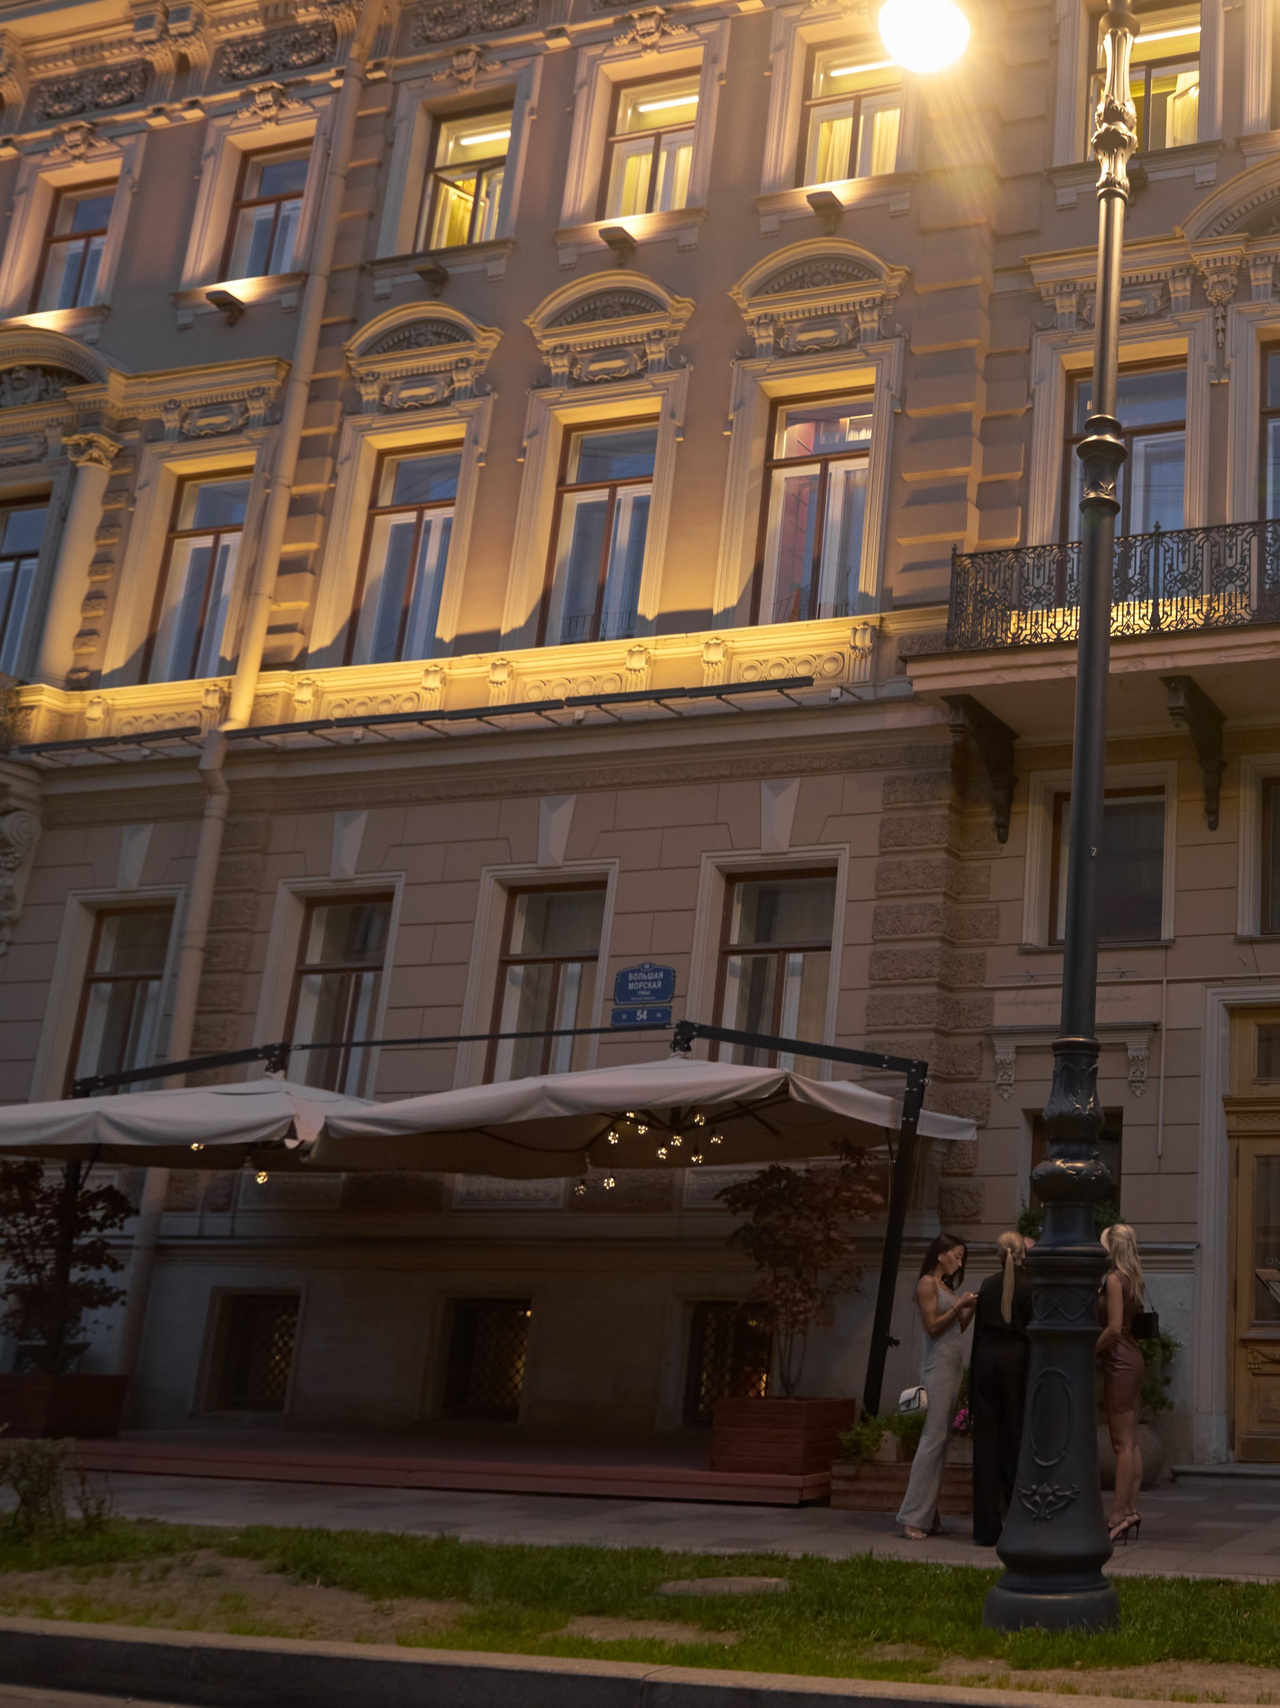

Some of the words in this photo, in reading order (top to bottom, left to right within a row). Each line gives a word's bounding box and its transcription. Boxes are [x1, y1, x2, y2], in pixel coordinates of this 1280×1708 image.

[628, 971, 664, 981] БОЛЬШАЯ
[628, 981, 662, 990] МОРСКАЯ
[636, 1009, 648, 1021] 54
